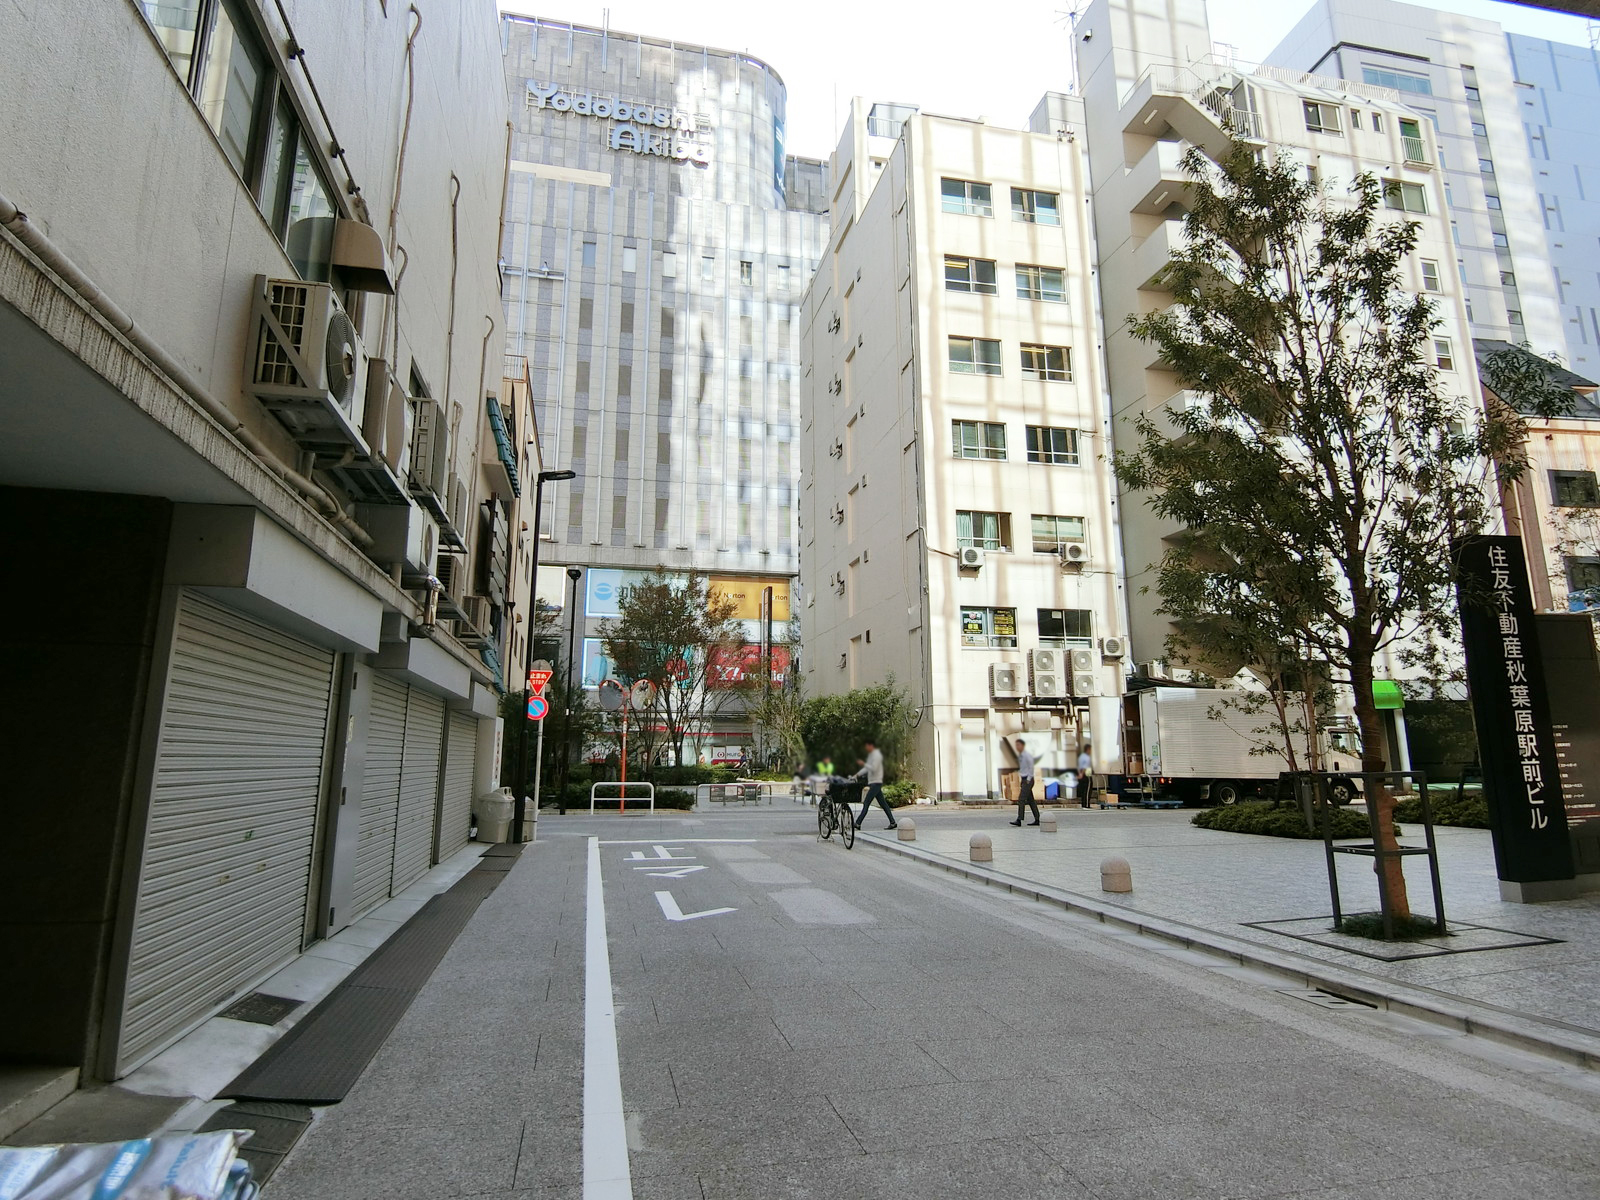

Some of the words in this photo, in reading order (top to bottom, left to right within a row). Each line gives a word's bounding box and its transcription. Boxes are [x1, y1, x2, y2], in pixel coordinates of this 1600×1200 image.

[526, 79, 696, 131] Yodobashi
[611, 124, 709, 164] Akiba
[1488, 545, 1548, 829] 住友不動産秋葉原駅前ビル
